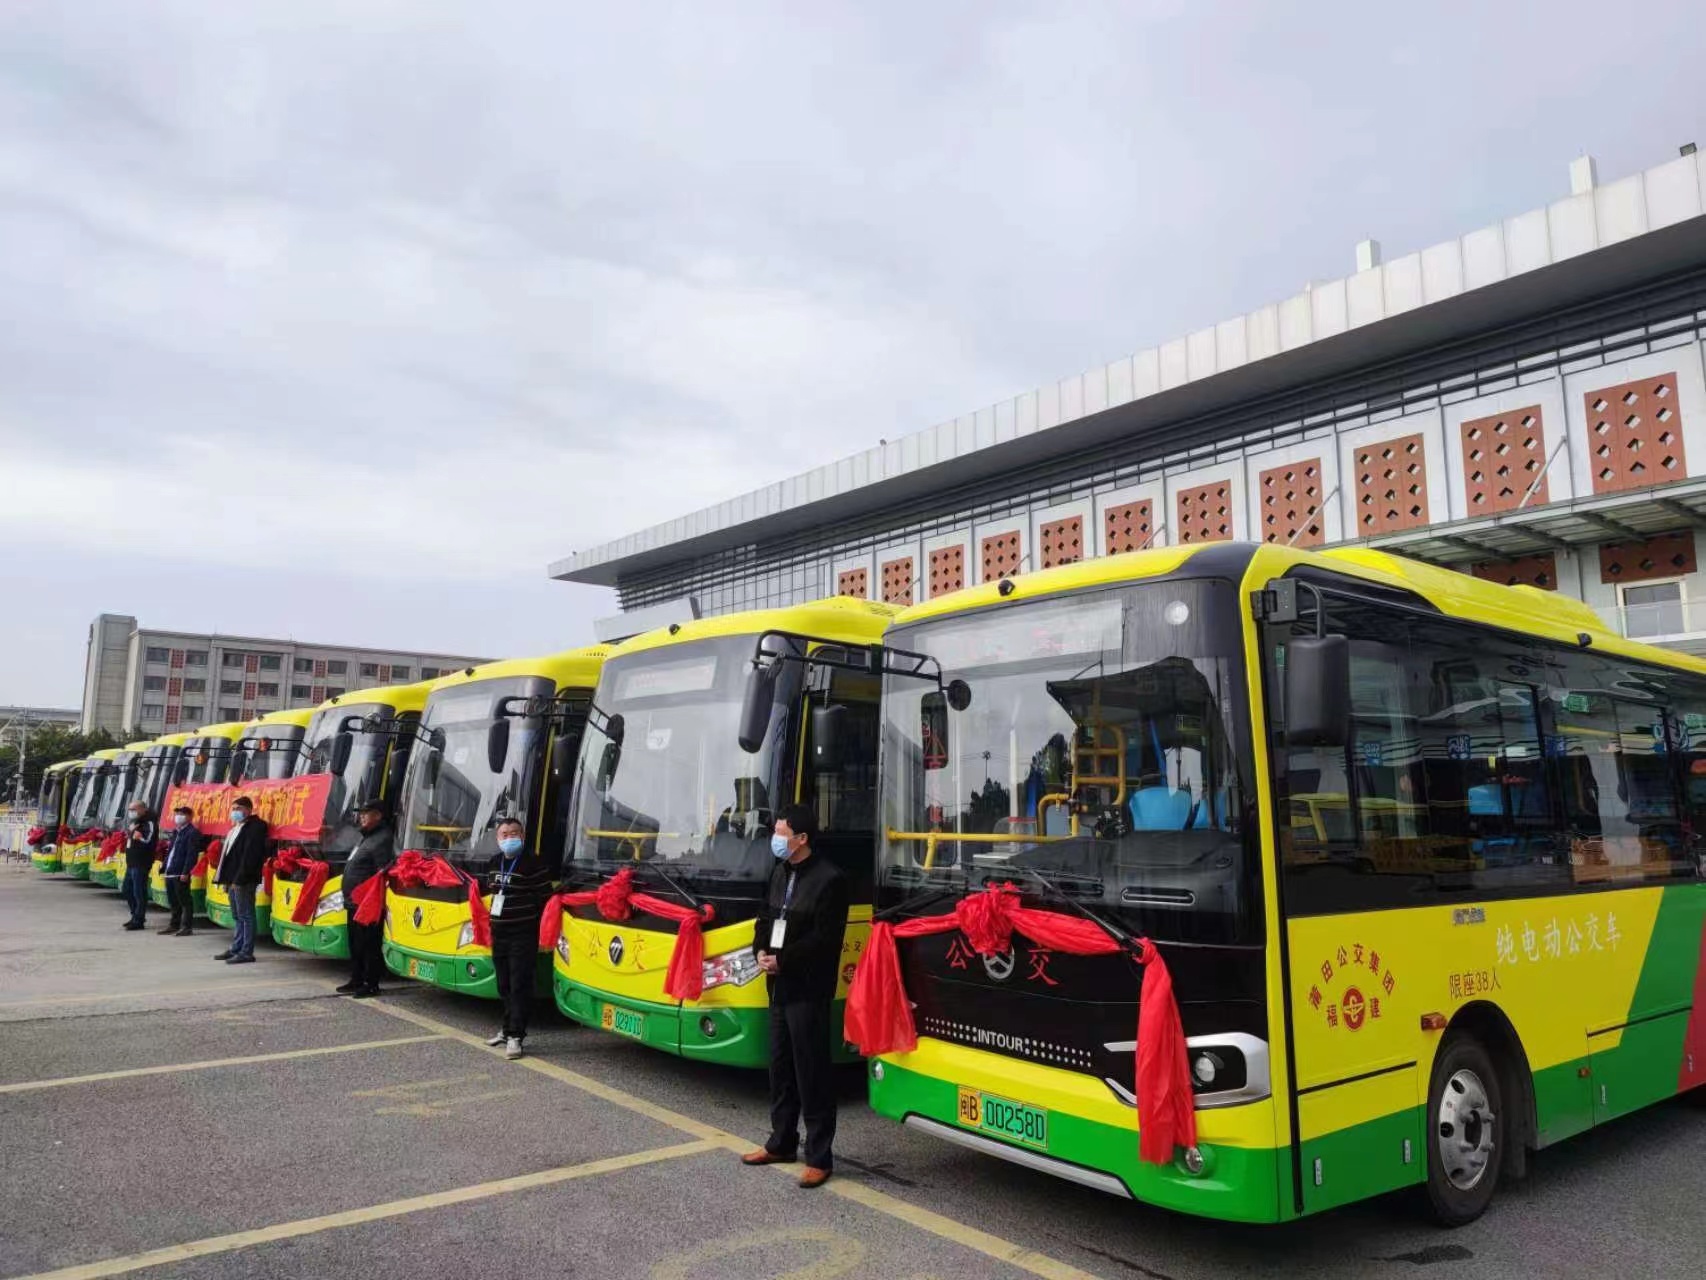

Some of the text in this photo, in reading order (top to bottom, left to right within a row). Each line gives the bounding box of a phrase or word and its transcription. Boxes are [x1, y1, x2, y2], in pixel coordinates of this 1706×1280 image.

[1496, 911, 1622, 964] 纯电动公交车
[1449, 967, 1502, 1000] 限座38人
[977, 1028, 1024, 1052] INTOUR
